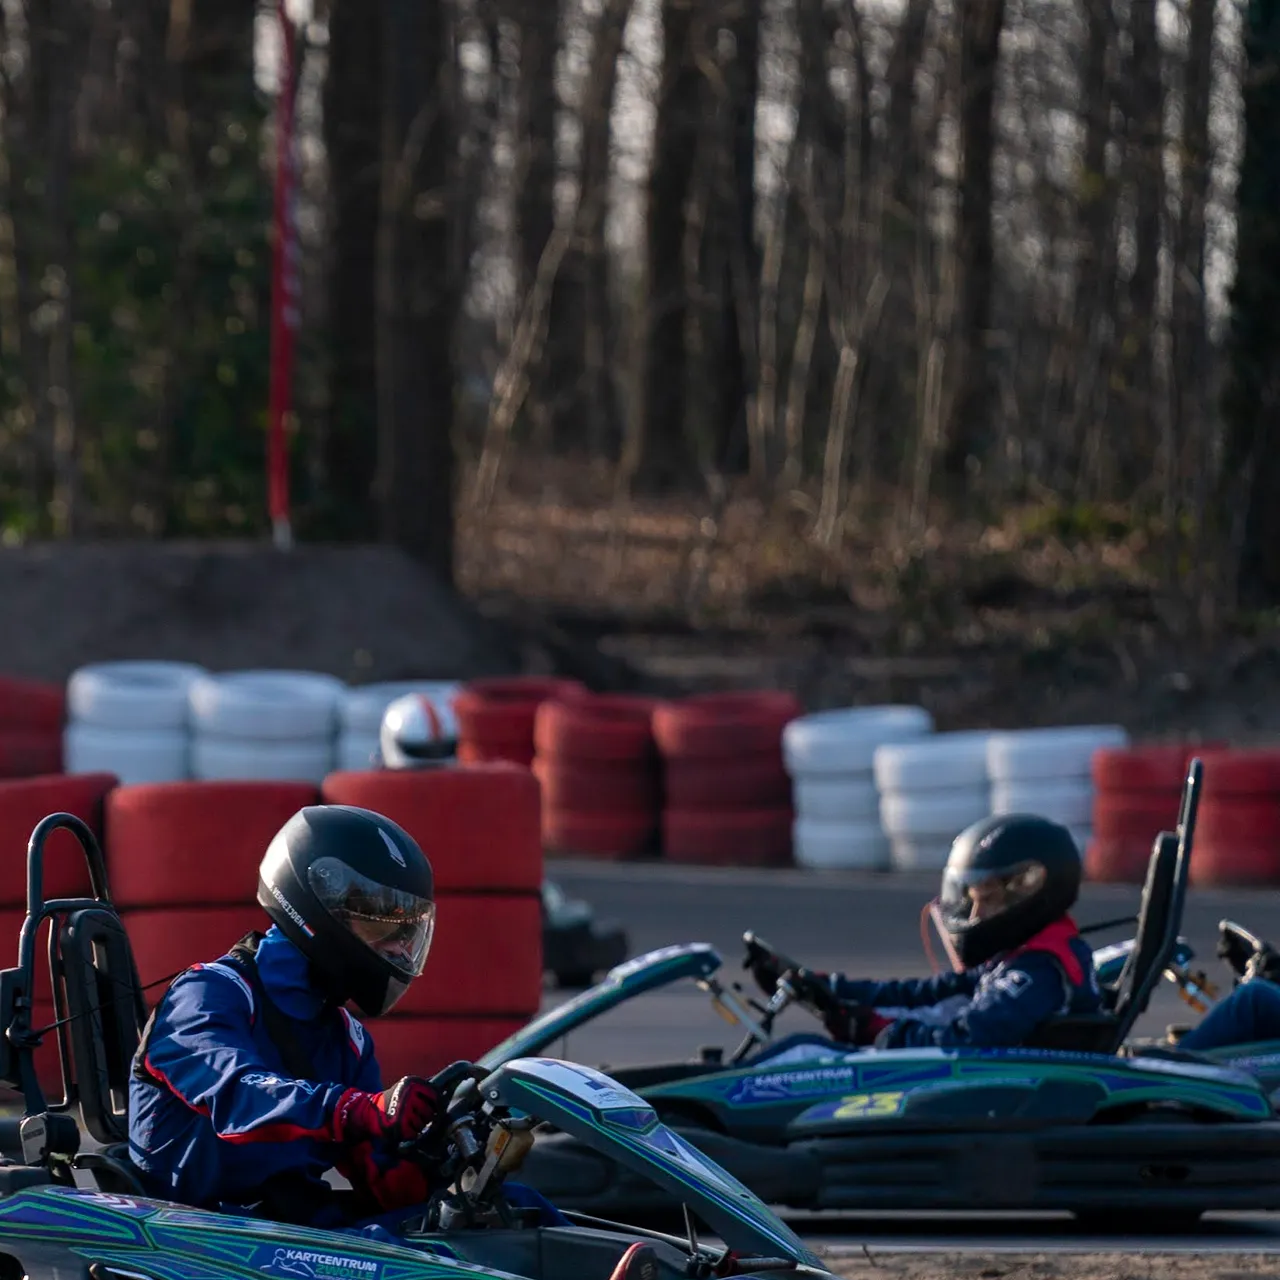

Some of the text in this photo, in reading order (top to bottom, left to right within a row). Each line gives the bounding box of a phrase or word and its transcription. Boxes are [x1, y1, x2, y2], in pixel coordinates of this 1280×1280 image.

[834, 1092, 904, 1118] 23
[287, 1250, 377, 1272] KARTCENTRUM
[315, 1265, 375, 1280] ZWOLLE
